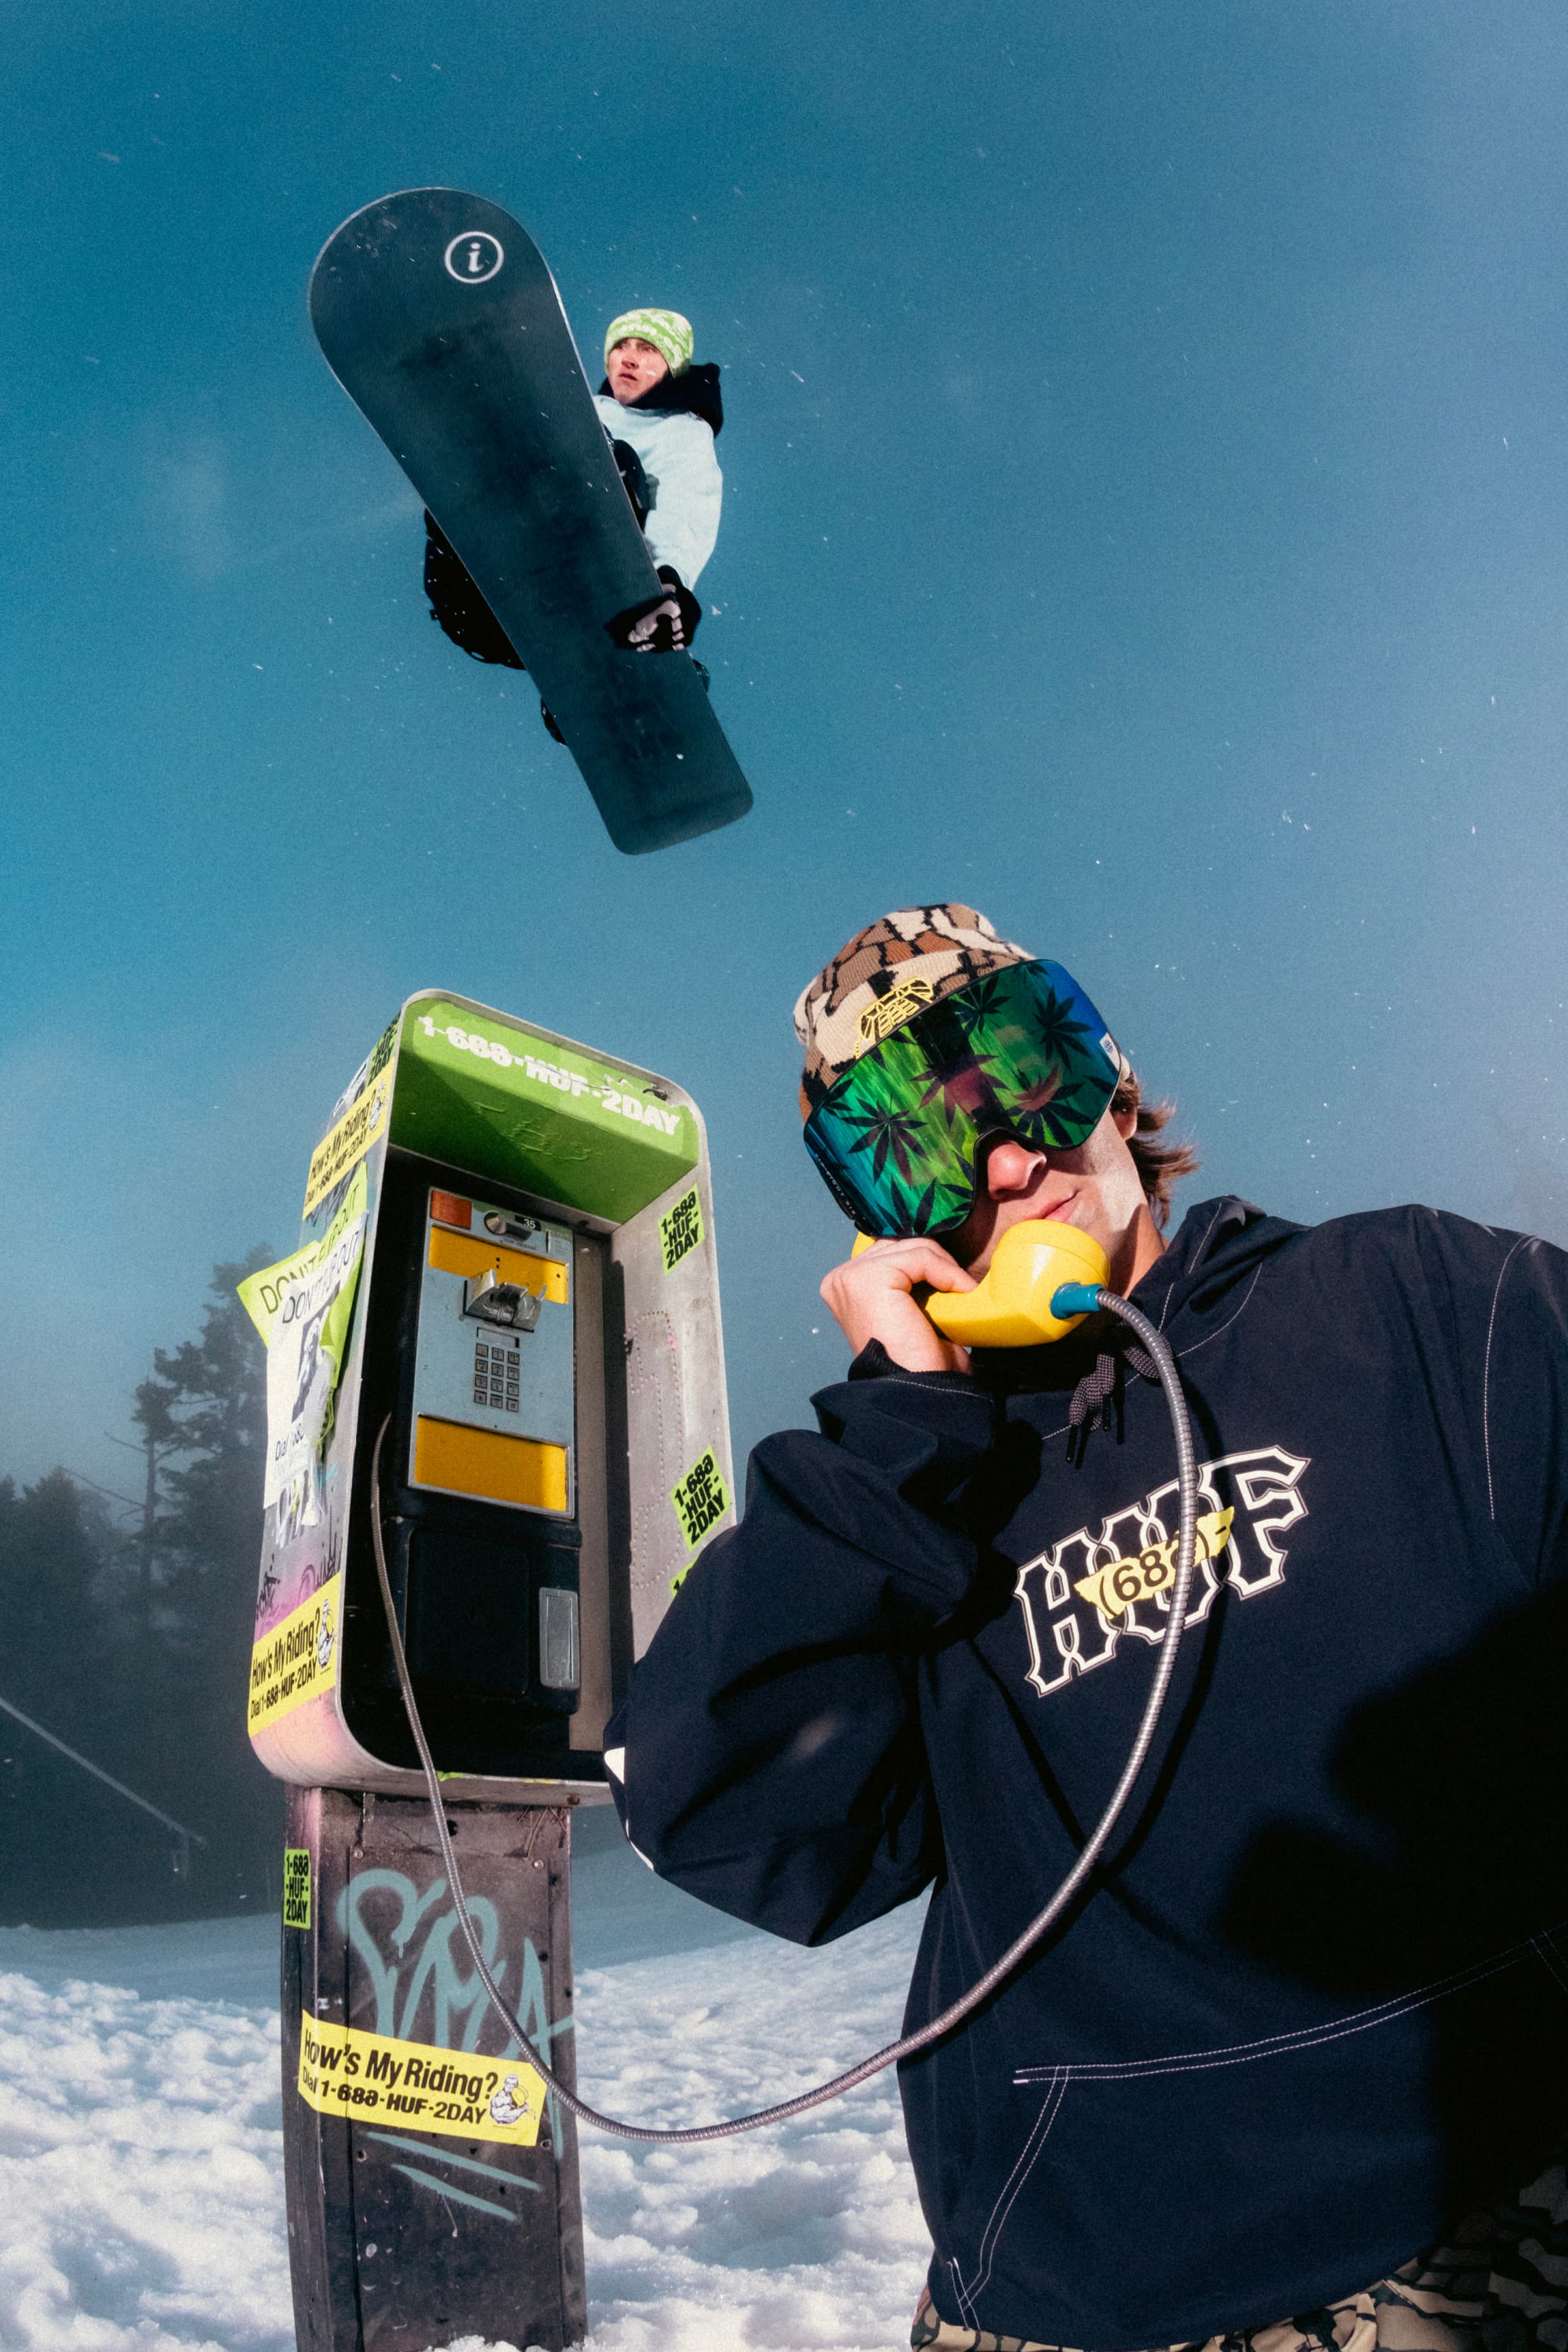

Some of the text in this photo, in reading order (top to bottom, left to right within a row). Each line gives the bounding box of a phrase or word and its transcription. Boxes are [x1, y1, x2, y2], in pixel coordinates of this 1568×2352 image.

[523, 1218, 536, 1229] 35
[666, 1222, 699, 1270] 2DAY
[688, 1488, 725, 1544] 2DAY
[1012, 1444, 1312, 1698] HUF
[252, 1607, 321, 1690] How's My Riding?
[250, 1695, 261, 1719] Dial
[286, 1899, 308, 1923] 2DAY
[303, 2066, 319, 2094] Dial
[304, 2028, 498, 2103] How's My Riding?
